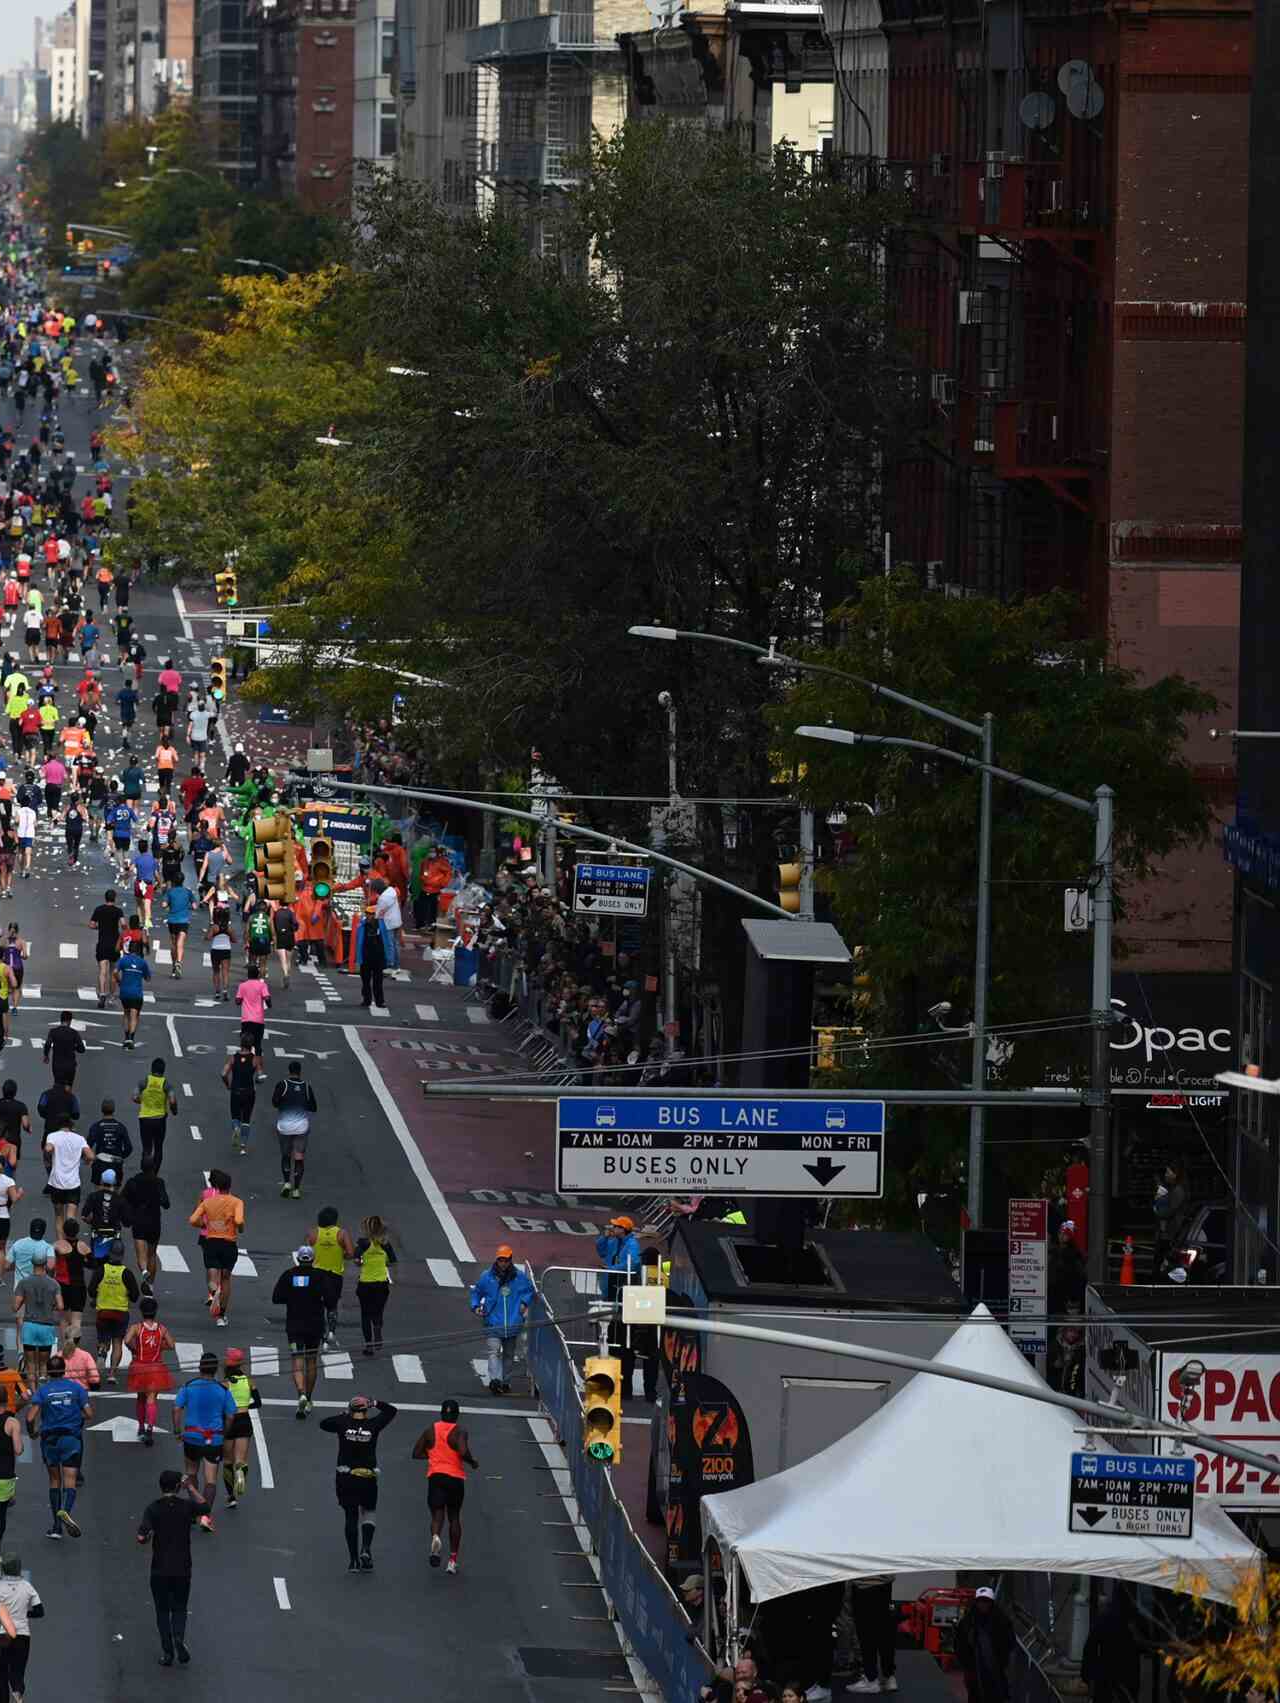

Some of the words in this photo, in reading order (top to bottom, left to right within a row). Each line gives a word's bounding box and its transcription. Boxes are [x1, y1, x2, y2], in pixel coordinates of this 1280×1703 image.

[329, 821, 368, 832] ENDURANCE
[596, 869, 615, 878] BUS
[617, 870, 643, 879] LANE
[1189, 1096, 1223, 1106] LIGHT
[658, 1107, 701, 1125] BUS
[721, 1107, 779, 1126] LANE
[603, 1156, 677, 1174] BUSES
[690, 1157, 749, 1175] ONLY
[681, 1177, 708, 1185] TURNS
[500, 1215, 601, 1236] BU
[1012, 1241, 1020, 1253] 3
[1012, 1298, 1020, 1312] 2
[1105, 1460, 1137, 1473] BUS
[1143, 1462, 1185, 1476] LANE
[719, 1472, 734, 1482] york
[1111, 1508, 1150, 1521] BUSES
[1156, 1510, 1186, 1523] ONLY
[1126, 1522, 1151, 1532] RIGHT
[1155, 1524, 1183, 1534] TURNS
